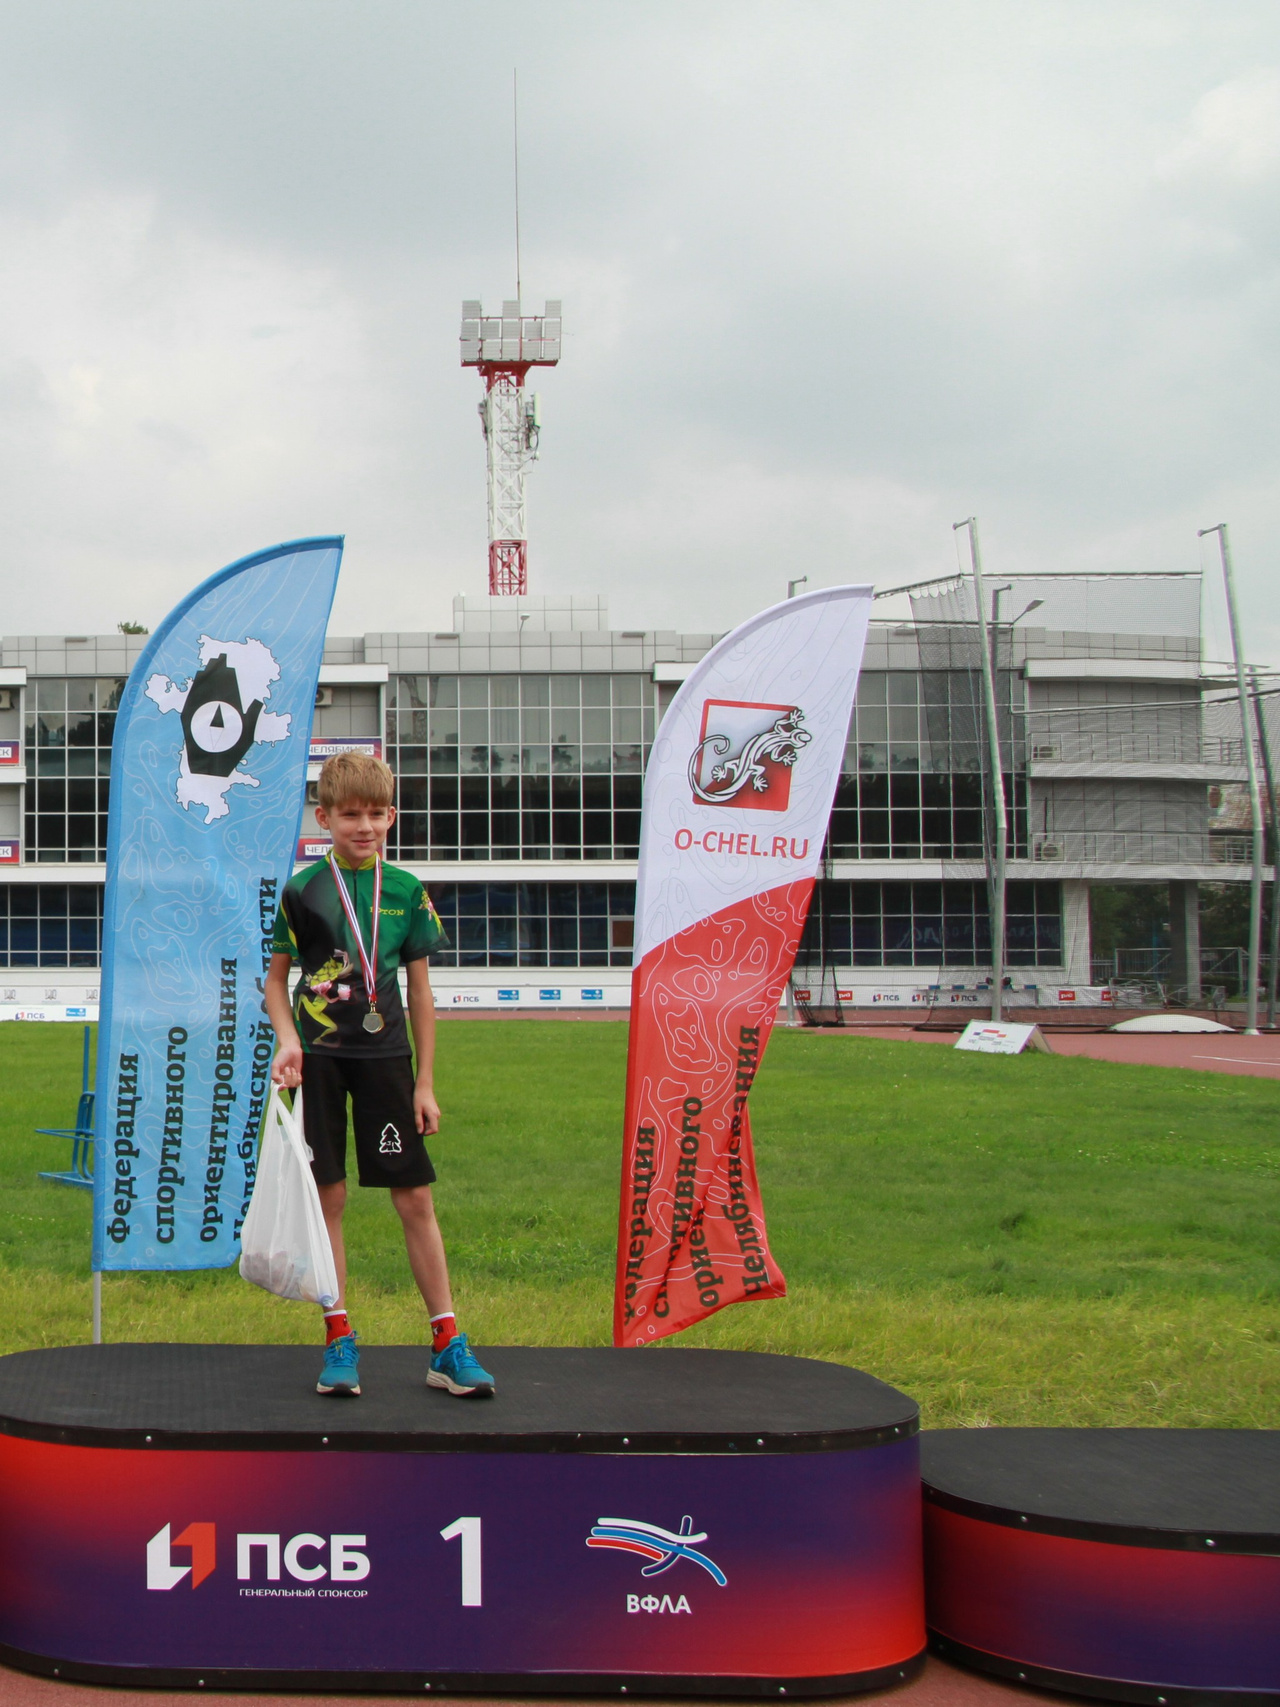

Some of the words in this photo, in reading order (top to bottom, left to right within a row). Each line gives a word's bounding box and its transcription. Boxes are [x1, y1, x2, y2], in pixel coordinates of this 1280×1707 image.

[674, 828, 809, 860] O-CHEL.RU
[156, 1026, 188, 1244] спортивного
[200, 958, 237, 1243] ориентирования
[107, 1053, 142, 1244] Федерация
[236, 1533, 371, 1583] ПСБ
[239, 1588, 315, 1598] ГЕНЕРАЛЬНЫЙ
[318, 1589, 369, 1598] СПОНСОР
[440, 1516, 482, 1607] 1
[627, 1594, 692, 1615] ВФЛА
